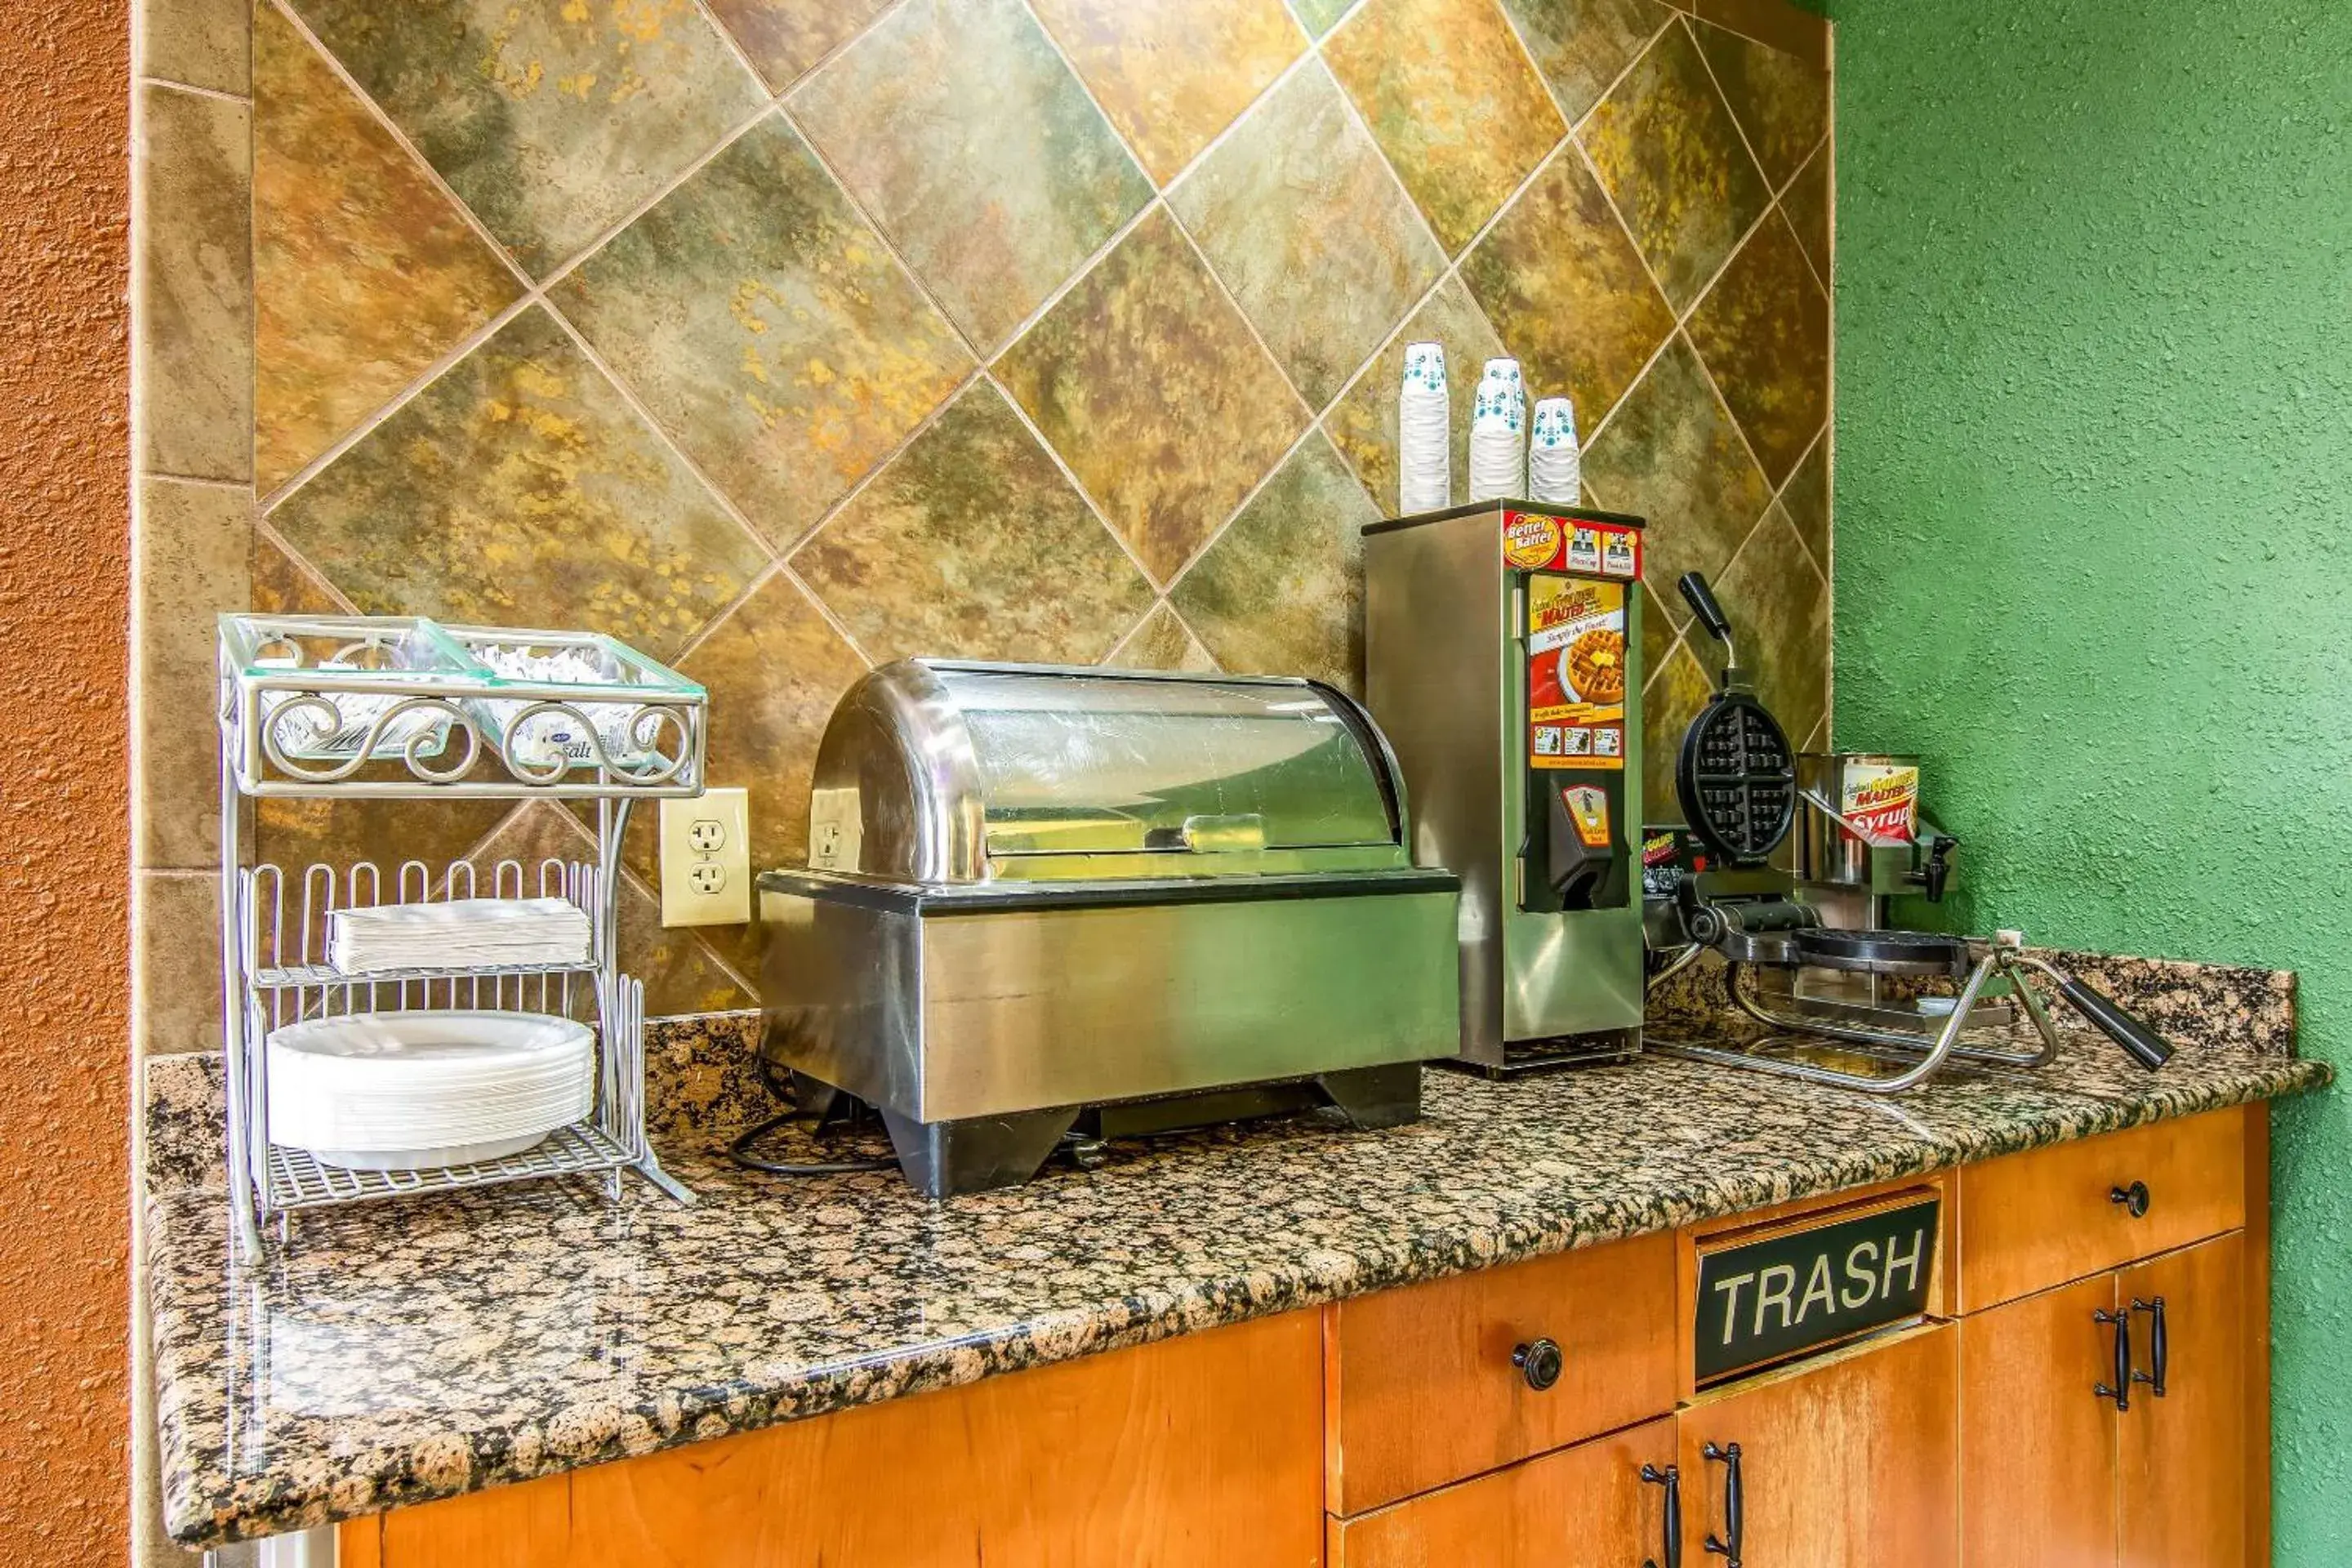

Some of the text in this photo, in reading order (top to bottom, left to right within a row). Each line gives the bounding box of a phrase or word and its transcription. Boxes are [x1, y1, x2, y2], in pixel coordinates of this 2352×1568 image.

[1508, 522, 1544, 539] Better
[1515, 531, 1552, 550] Batter
[1856, 784, 1906, 805] MALTED
[1852, 806, 1909, 832] Syrup
[1714, 1228, 1924, 1345] TRASH
